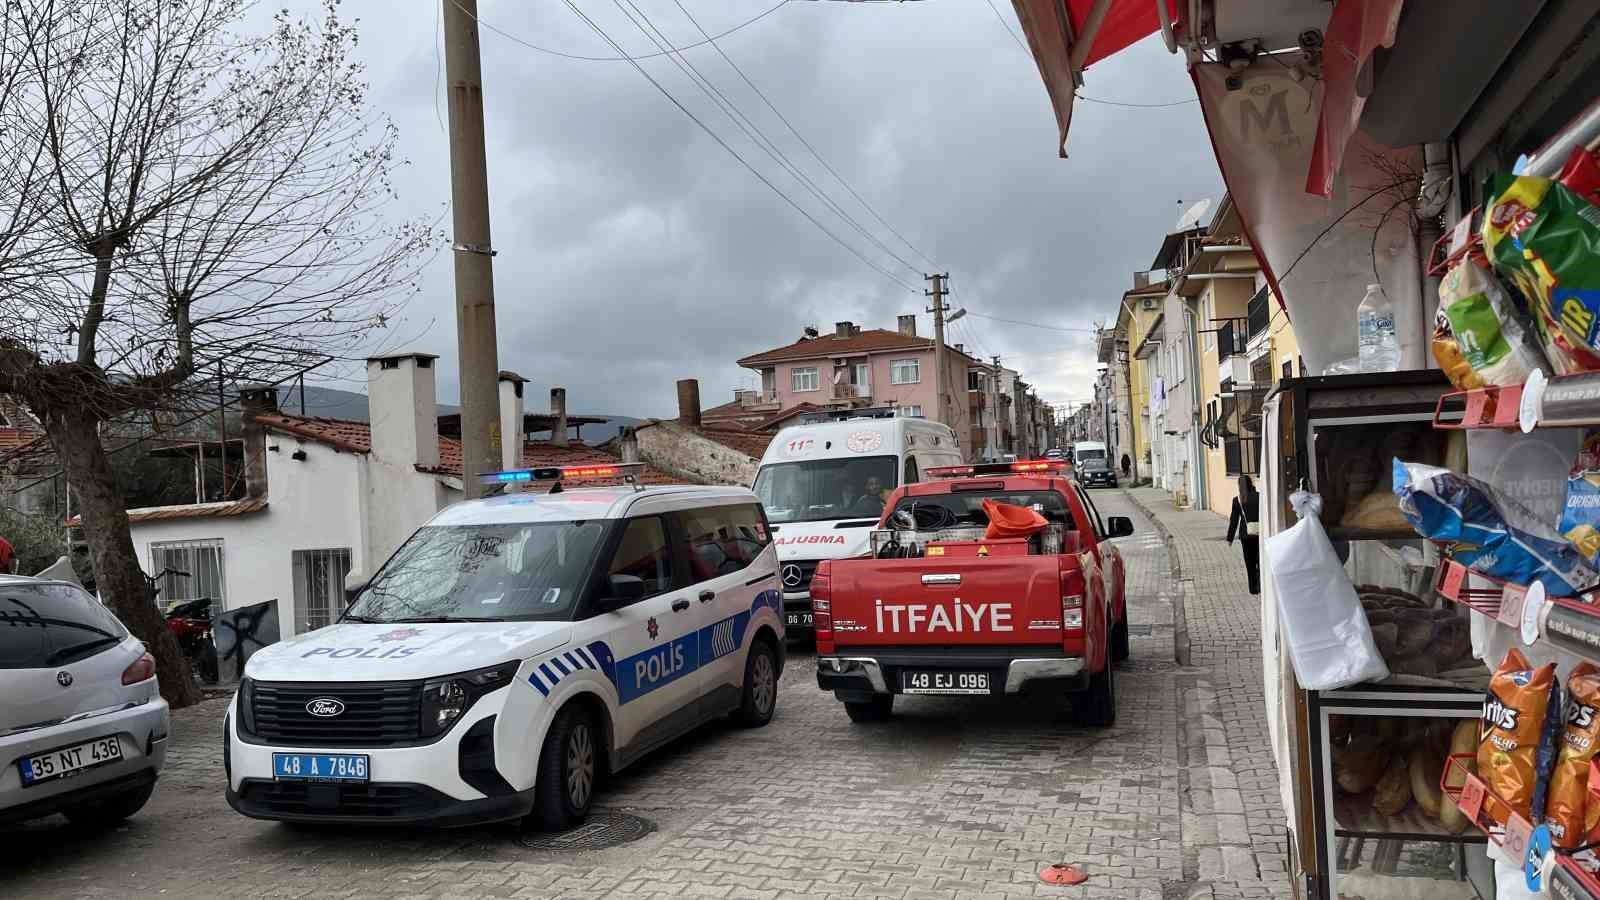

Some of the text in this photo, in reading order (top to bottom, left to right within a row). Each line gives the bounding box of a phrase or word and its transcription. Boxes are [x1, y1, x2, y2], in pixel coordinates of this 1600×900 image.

[875, 597, 1014, 633] İTFAİYE
[635, 642, 684, 688] POLİS
[911, 673, 987, 688] 48 EJ 096
[313, 701, 336, 713] Ford
[1483, 701, 1517, 729] ritos
[31, 757, 54, 777] 35
[60, 747, 82, 770] NT
[92, 739, 118, 760] 436
[284, 757, 365, 777] 48 A 7846
